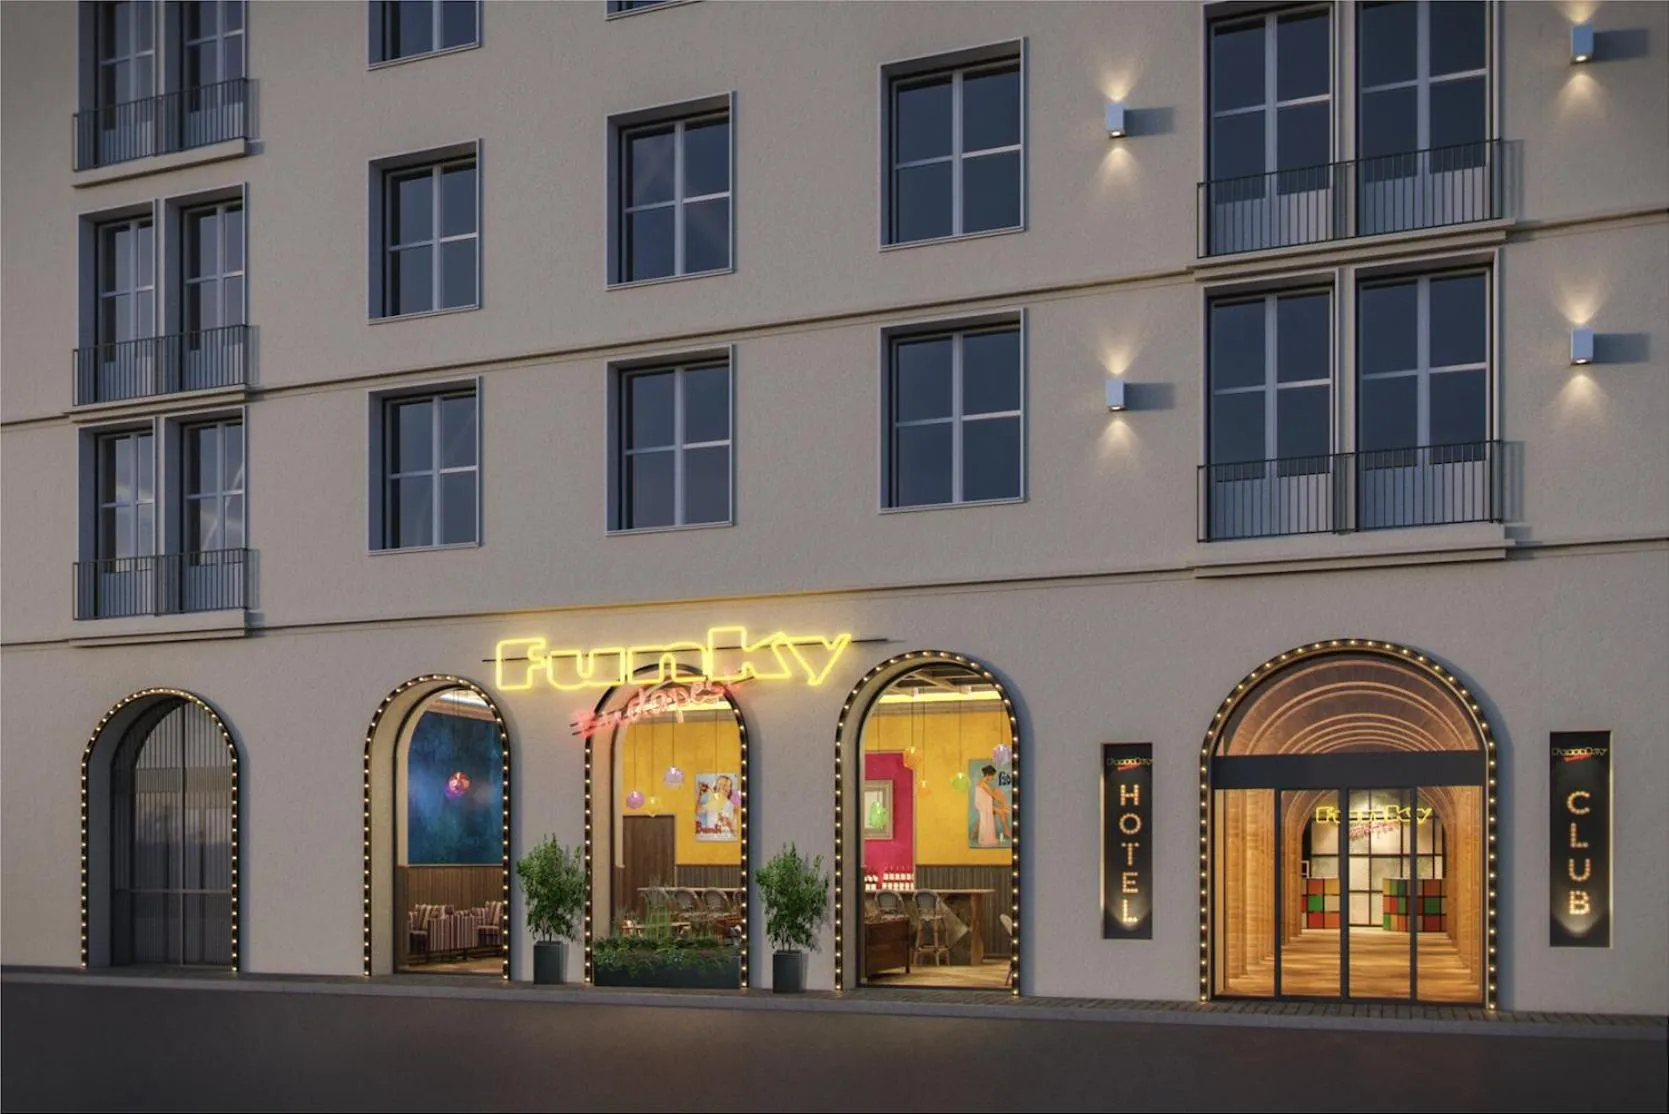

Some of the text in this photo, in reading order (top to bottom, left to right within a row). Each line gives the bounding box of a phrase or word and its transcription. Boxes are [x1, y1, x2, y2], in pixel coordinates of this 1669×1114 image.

[496, 626, 851, 690] Funky
[1119, 784, 1142, 923] HOTEL
[1567, 791, 1591, 915] CLUB
